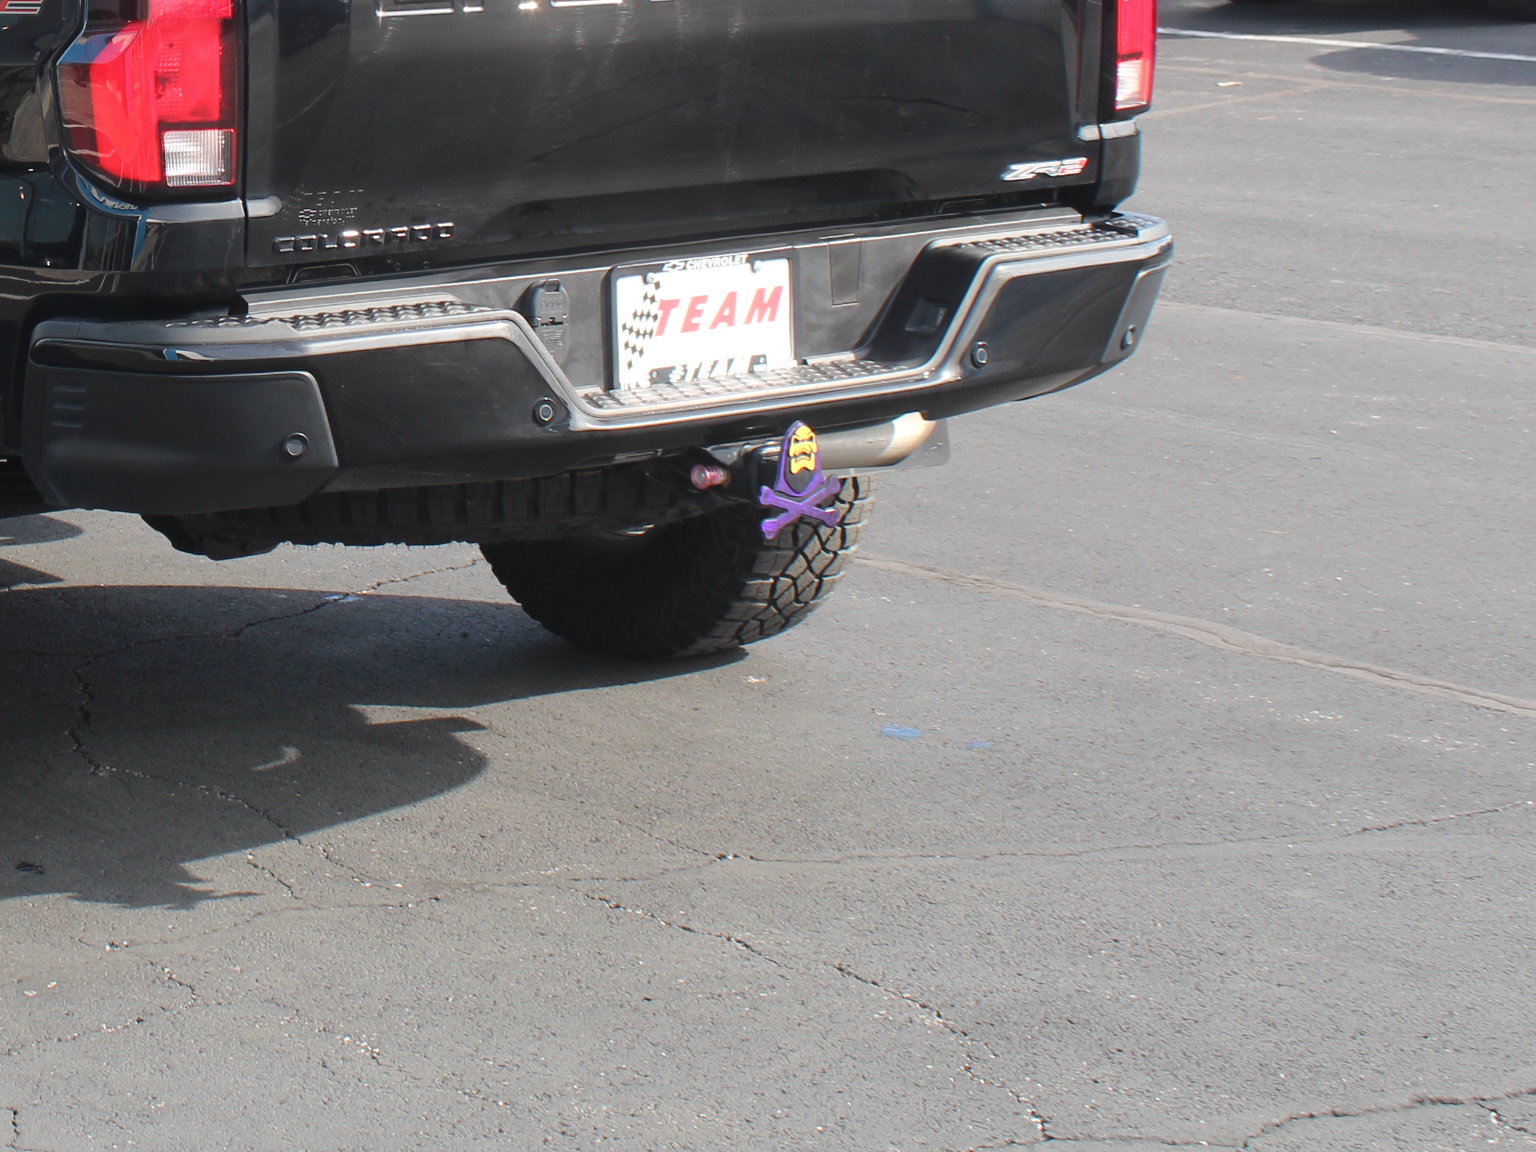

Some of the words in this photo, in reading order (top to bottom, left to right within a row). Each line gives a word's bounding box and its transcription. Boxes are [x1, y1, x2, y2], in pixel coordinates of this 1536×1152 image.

[1001, 157, 1088, 181] ZR2
[685, 253, 749, 271] CHEVROLET
[655, 285, 784, 337] TEAM
